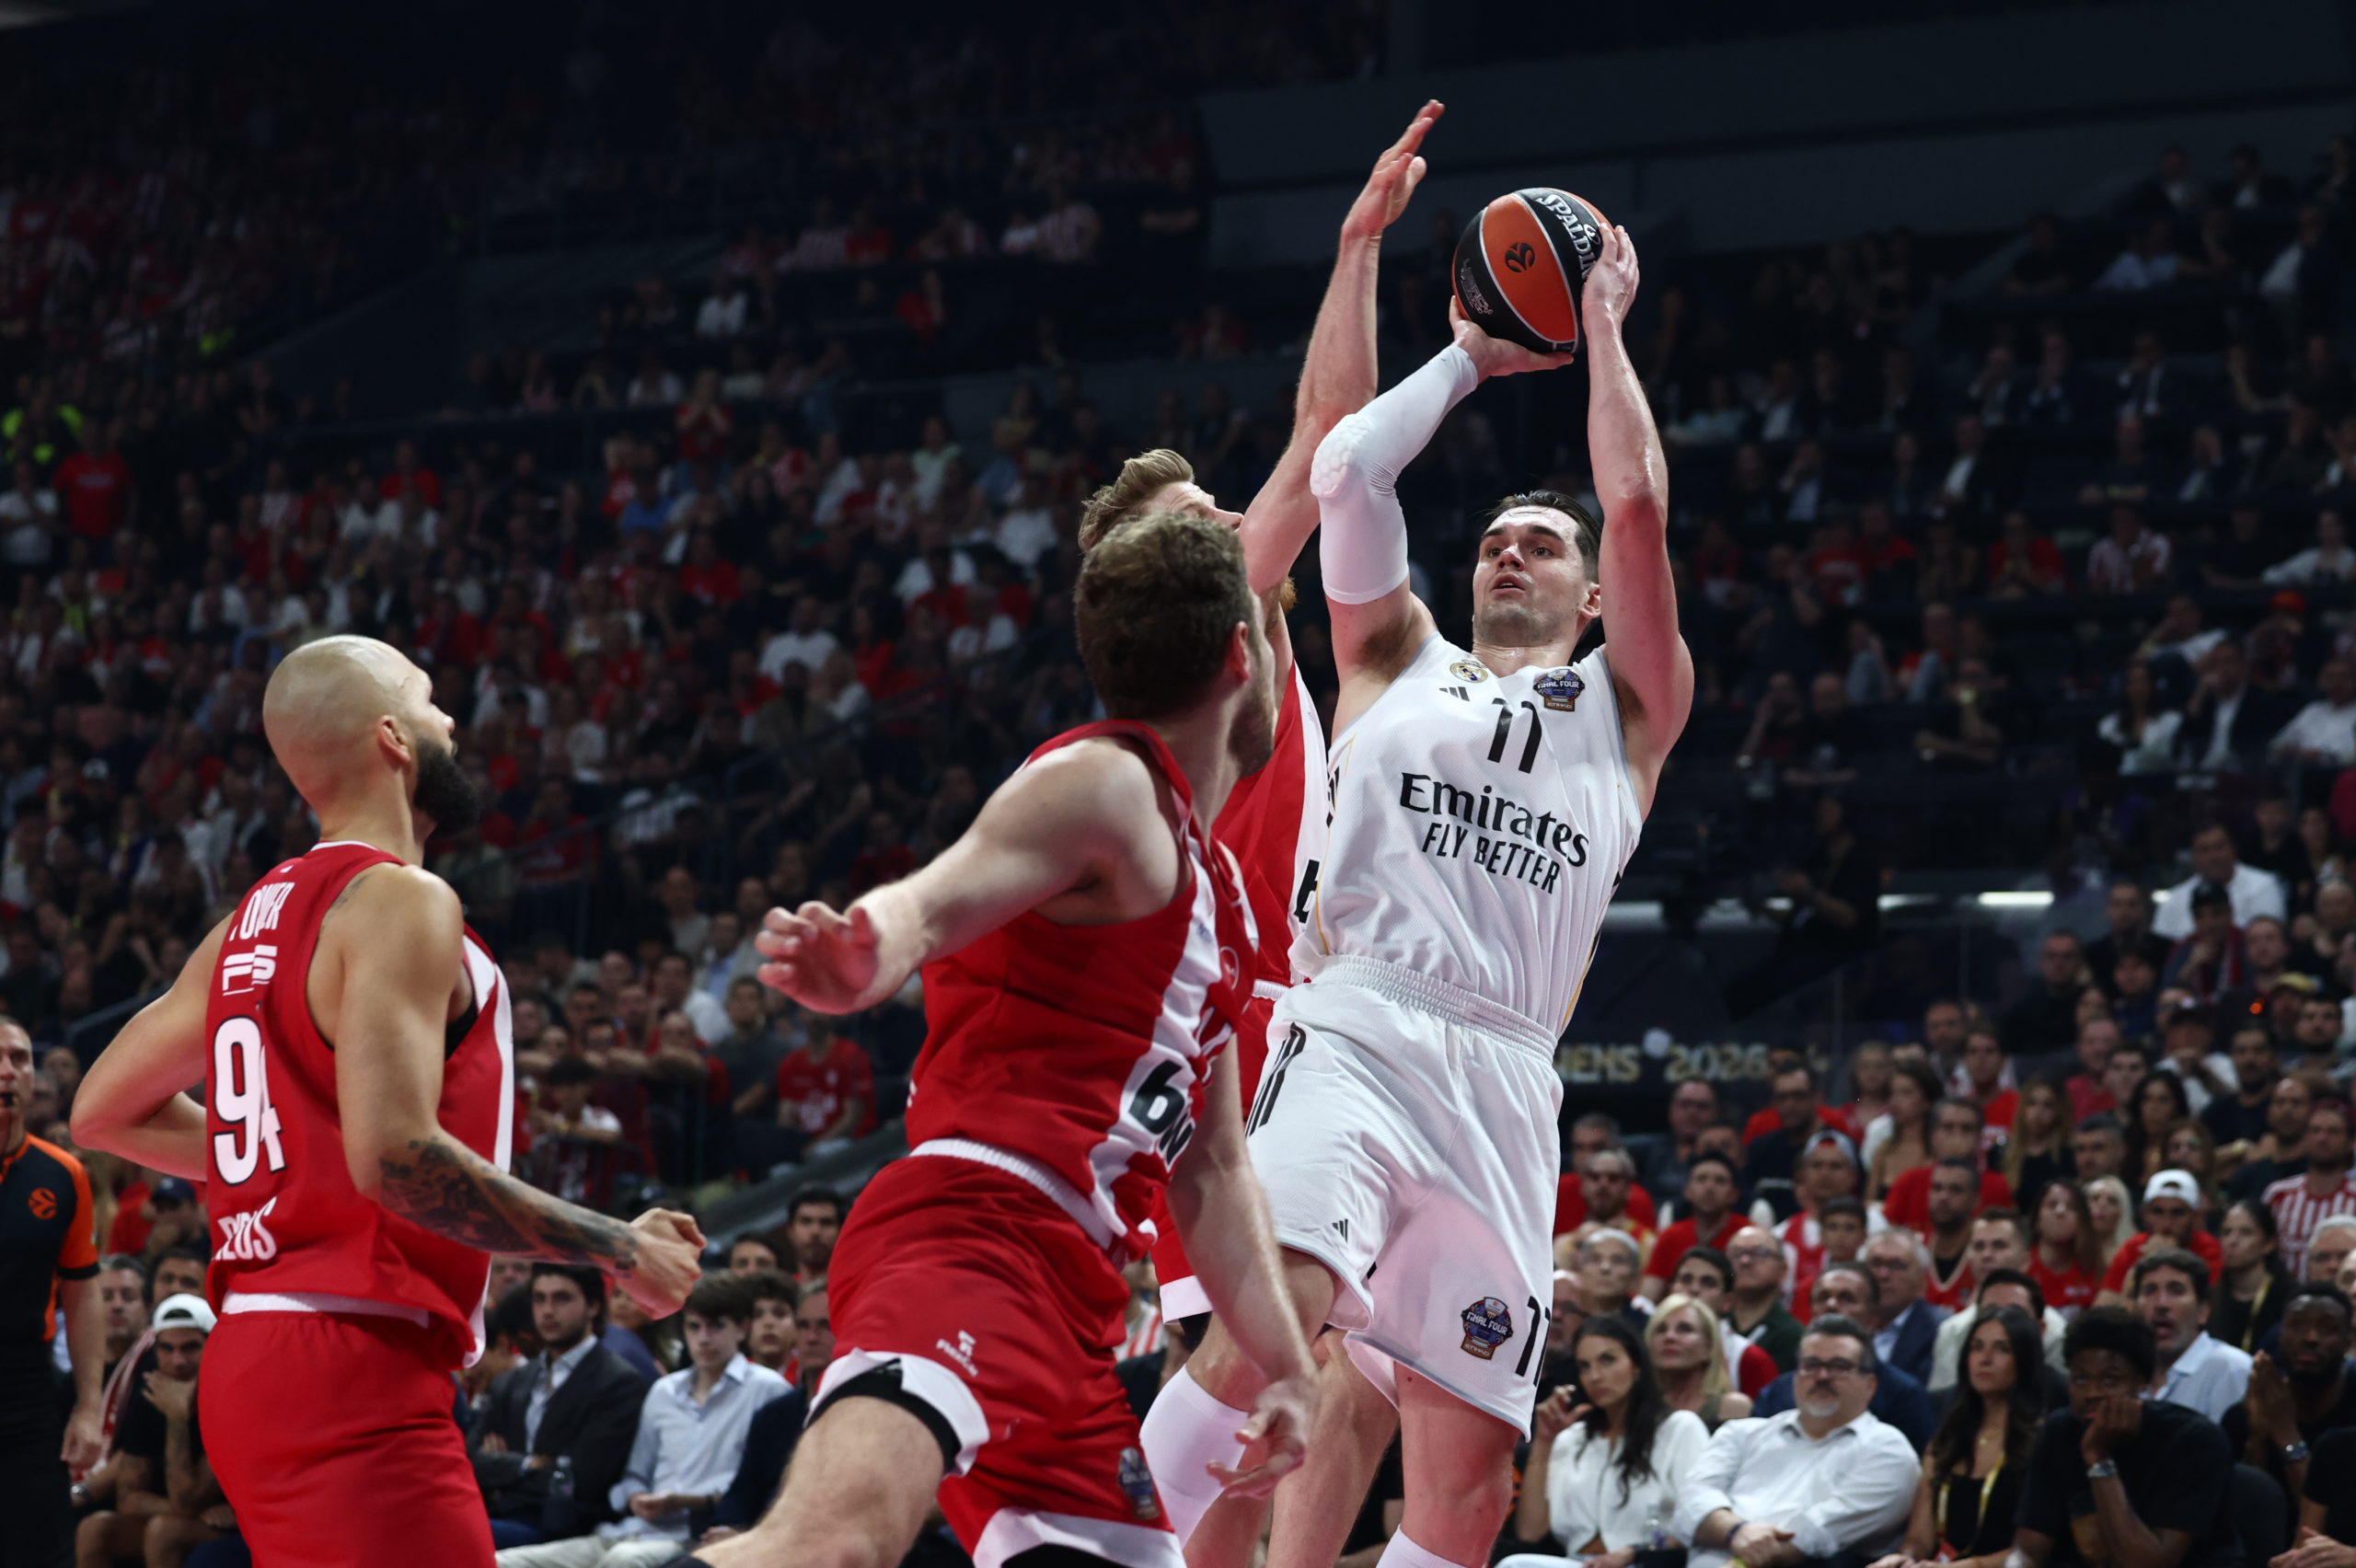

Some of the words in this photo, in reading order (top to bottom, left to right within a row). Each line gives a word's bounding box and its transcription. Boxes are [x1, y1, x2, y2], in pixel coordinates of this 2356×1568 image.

[1535, 194, 1597, 280] SPALDIN
[1560, 680, 1579, 688] FOUR
[1487, 698, 1542, 774] 11
[1400, 772, 1589, 868] Emirates
[1422, 822, 1469, 859] FLY
[1473, 836, 1561, 894] BETTER
[1466, 1311, 1487, 1327] FINAL
[1488, 1320, 1508, 1336] FOUR
